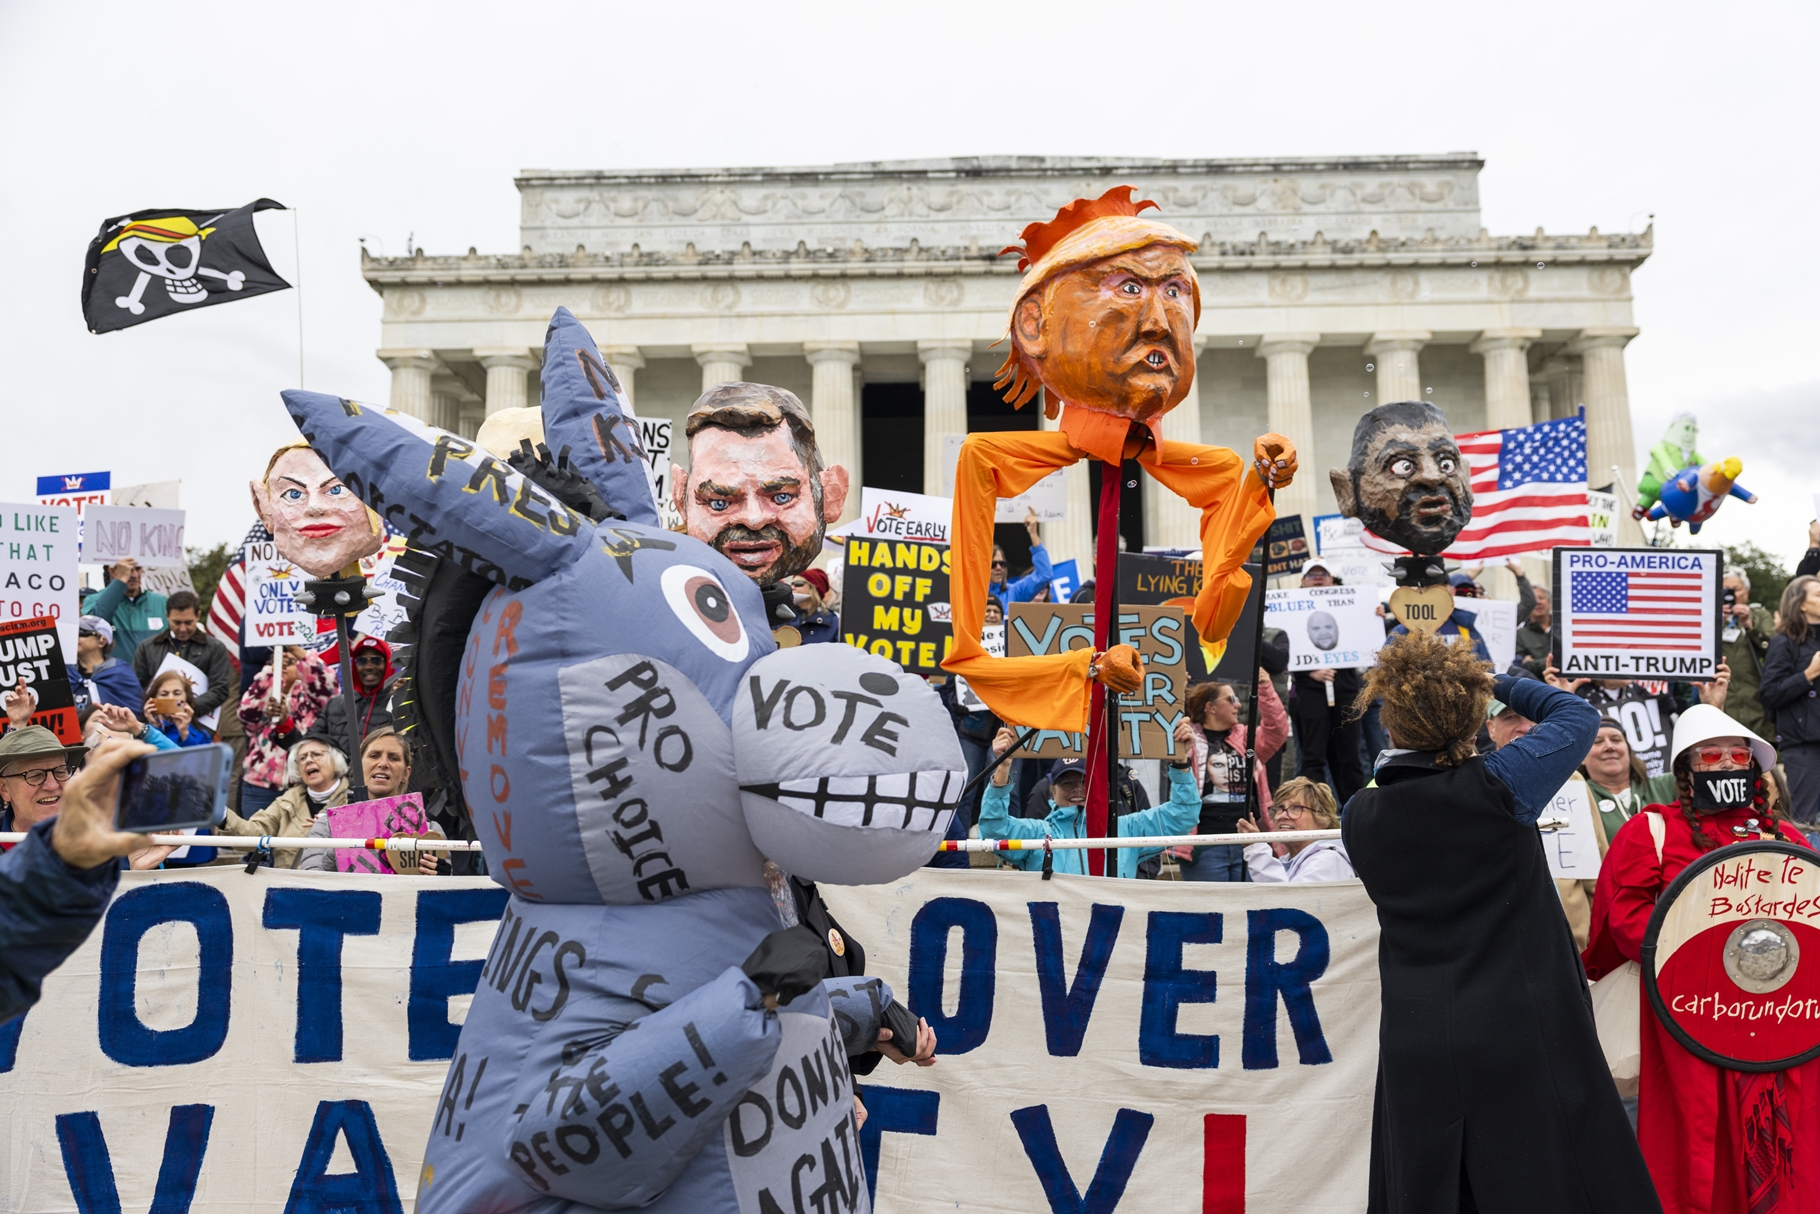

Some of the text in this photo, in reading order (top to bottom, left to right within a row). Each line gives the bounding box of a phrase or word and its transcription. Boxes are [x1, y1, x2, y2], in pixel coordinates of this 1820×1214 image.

[14, 512, 60, 534] LIKE
[867, 504, 947, 540] VOTE EARLY
[96, 520, 132, 556] NO
[251, 543, 274, 562] NO
[1569, 554, 1704, 571] PRO-AMERICA
[867, 572, 932, 602] OFF
[1136, 573, 1187, 595] LYING
[1309, 587, 1356, 597] CONGRESS
[32, 602, 60, 620] GO
[1268, 599, 1355, 613] BLUER THAN
[1405, 604, 1437, 620] TOOL
[255, 621, 295, 637] VOTE
[873, 605, 922, 635] MY
[1323, 651, 1360, 664] EYES
[1566, 655, 1713, 674] ANTI-TRUMP
[604, 660, 694, 774] PRO
[750, 675, 910, 758] VOTE
[1706, 778, 1747, 803] VOTE
[583, 725, 691, 901] CHOICE
[908, 896, 1333, 1070] OVER
[509, 1021, 729, 1191] PEOPLE!
